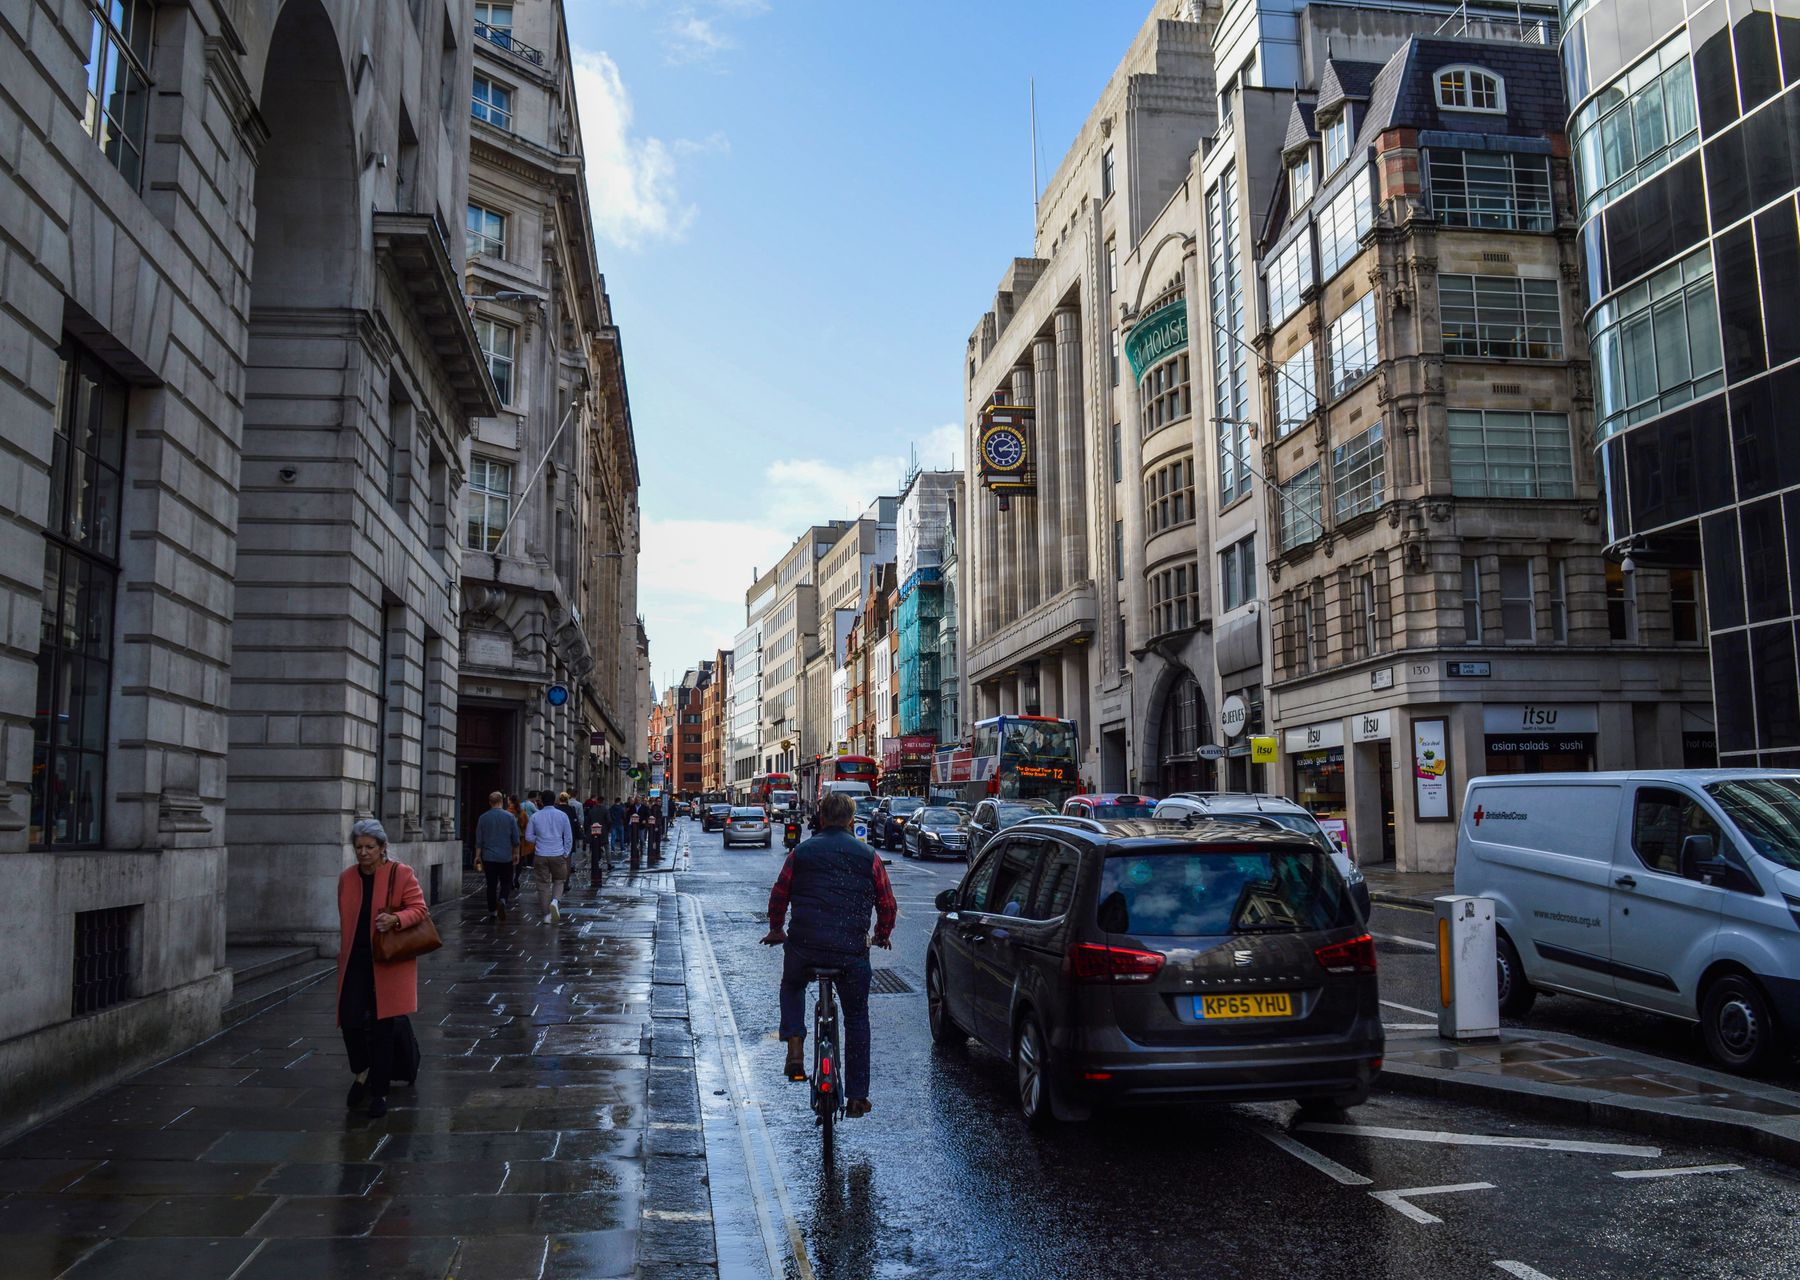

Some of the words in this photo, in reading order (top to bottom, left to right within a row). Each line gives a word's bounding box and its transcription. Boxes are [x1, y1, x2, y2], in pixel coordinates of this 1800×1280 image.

[1144, 316, 1189, 361] HOUSE
[1412, 665, 1430, 675] 130
[1226, 707, 1245, 725] JEEVES
[1522, 705, 1558, 725] itsu
[1363, 715, 1379, 734] itsu
[1307, 727, 1321, 744] itsu
[1256, 745, 1273, 755] itsu
[1491, 740, 1517, 751] asian
[1519, 740, 1550, 751] salads
[1559, 740, 1583, 751] sushi
[1053, 768, 1064, 779] T2
[1485, 811, 1528, 821] BritishRedCross
[1533, 909, 1602, 928] www.redcross.org.uk
[1205, 996, 1251, 1015] KP65
[1253, 995, 1288, 1014] YHU
